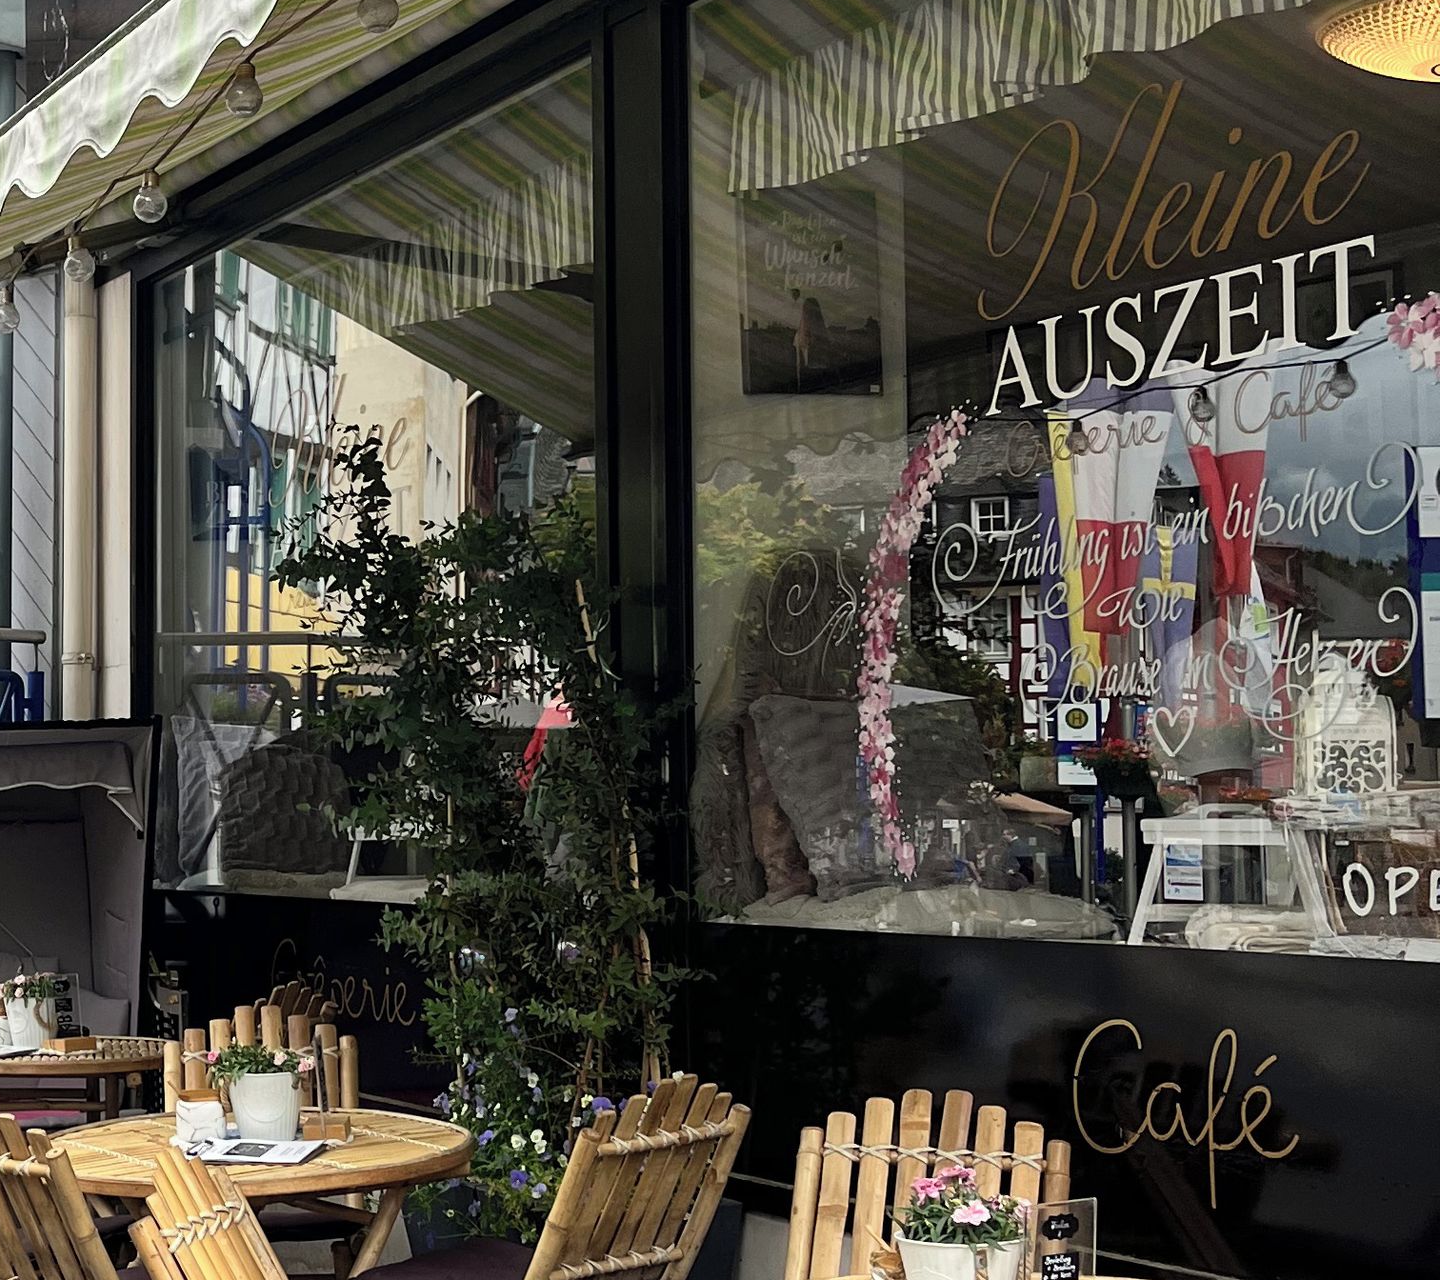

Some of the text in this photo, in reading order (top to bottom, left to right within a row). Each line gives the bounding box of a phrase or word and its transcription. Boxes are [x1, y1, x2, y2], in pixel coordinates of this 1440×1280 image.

[978, 78, 1372, 321] Kleine
[985, 235, 1376, 417] AUSZEIT
[1006, 410, 1168, 478] Crêerie
[1073, 1019, 1299, 1209] Café
